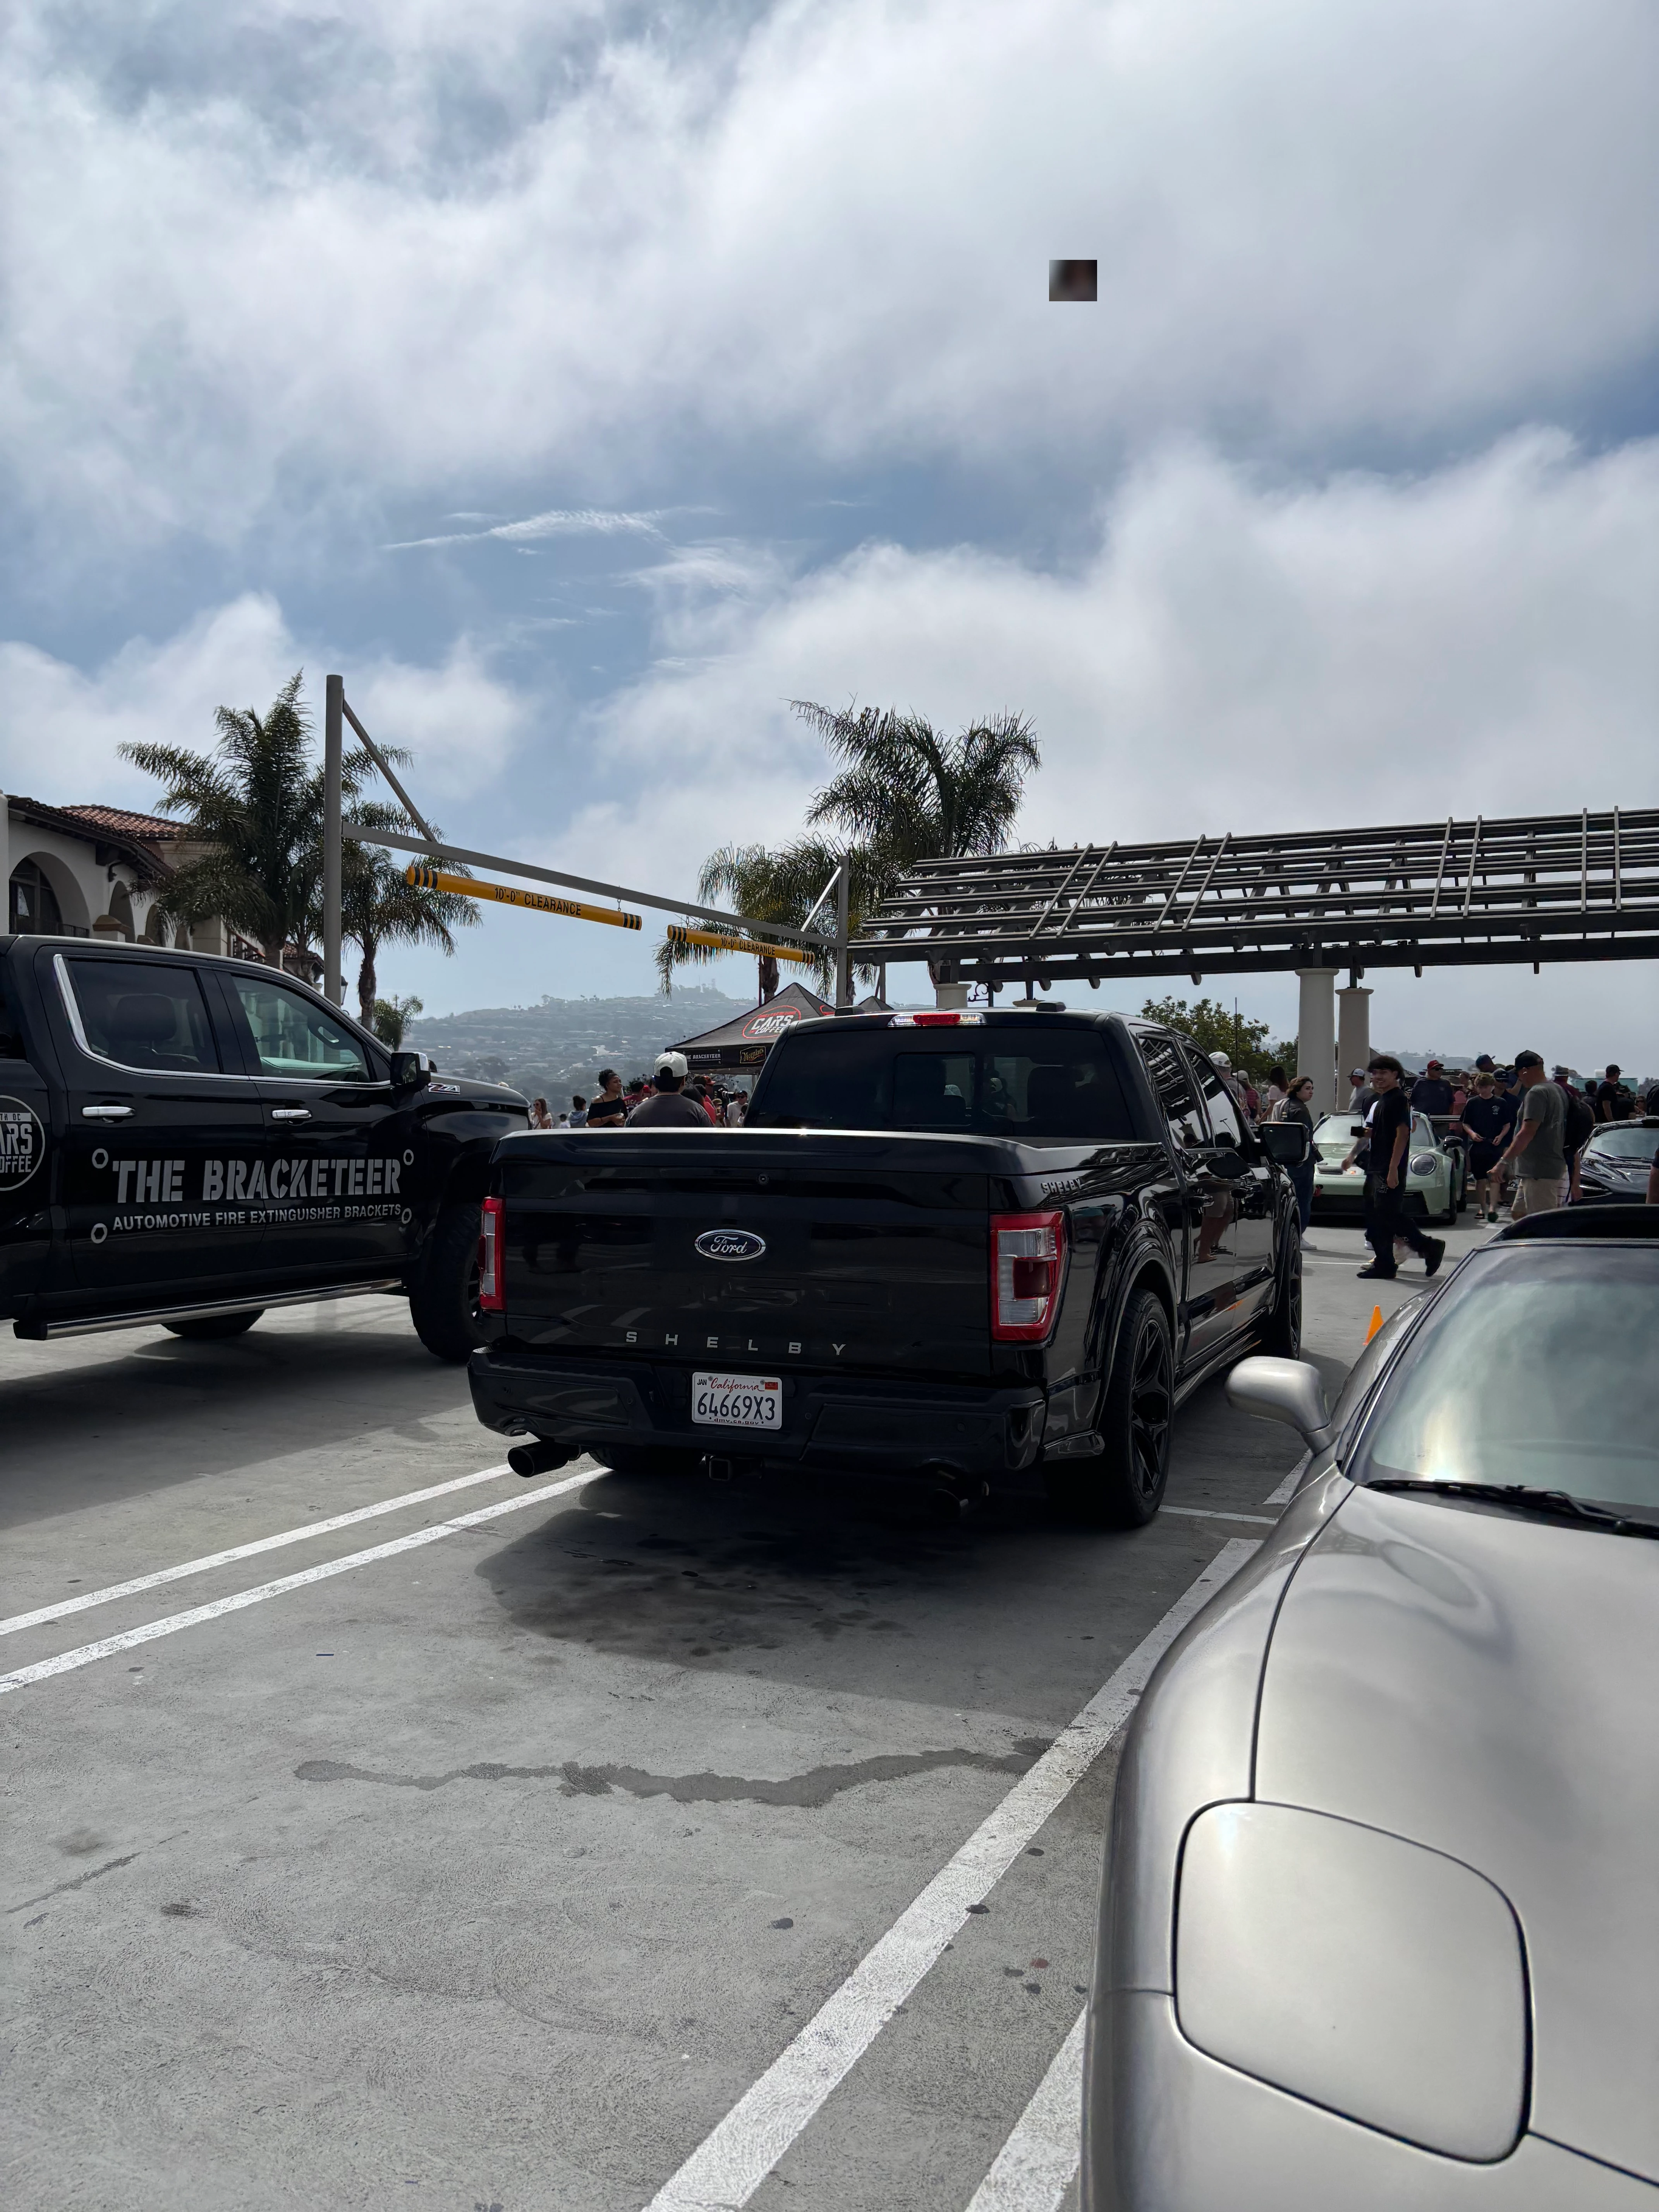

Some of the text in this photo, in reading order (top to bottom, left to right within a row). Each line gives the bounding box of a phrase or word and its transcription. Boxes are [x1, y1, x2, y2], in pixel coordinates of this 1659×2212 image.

[524, 893, 581, 916] CLEARANCE
[739, 940, 775, 955] CLEARANCE
[751, 1015, 794, 1030] CARS
[0, 1155, 32, 1173] OFFEE
[112, 1159, 400, 1203] THE BRACKETEER
[1041, 1178, 1081, 1194] SHELBY
[113, 1204, 401, 1230] AUTOMOTIVE FIRE EXTINGUISHER BRACKETS
[711, 1236, 747, 1253] Ford
[626, 1331, 846, 1355] SHELBY
[711, 1377, 765, 1393] California
[697, 1392, 775, 1420] 64669X3
